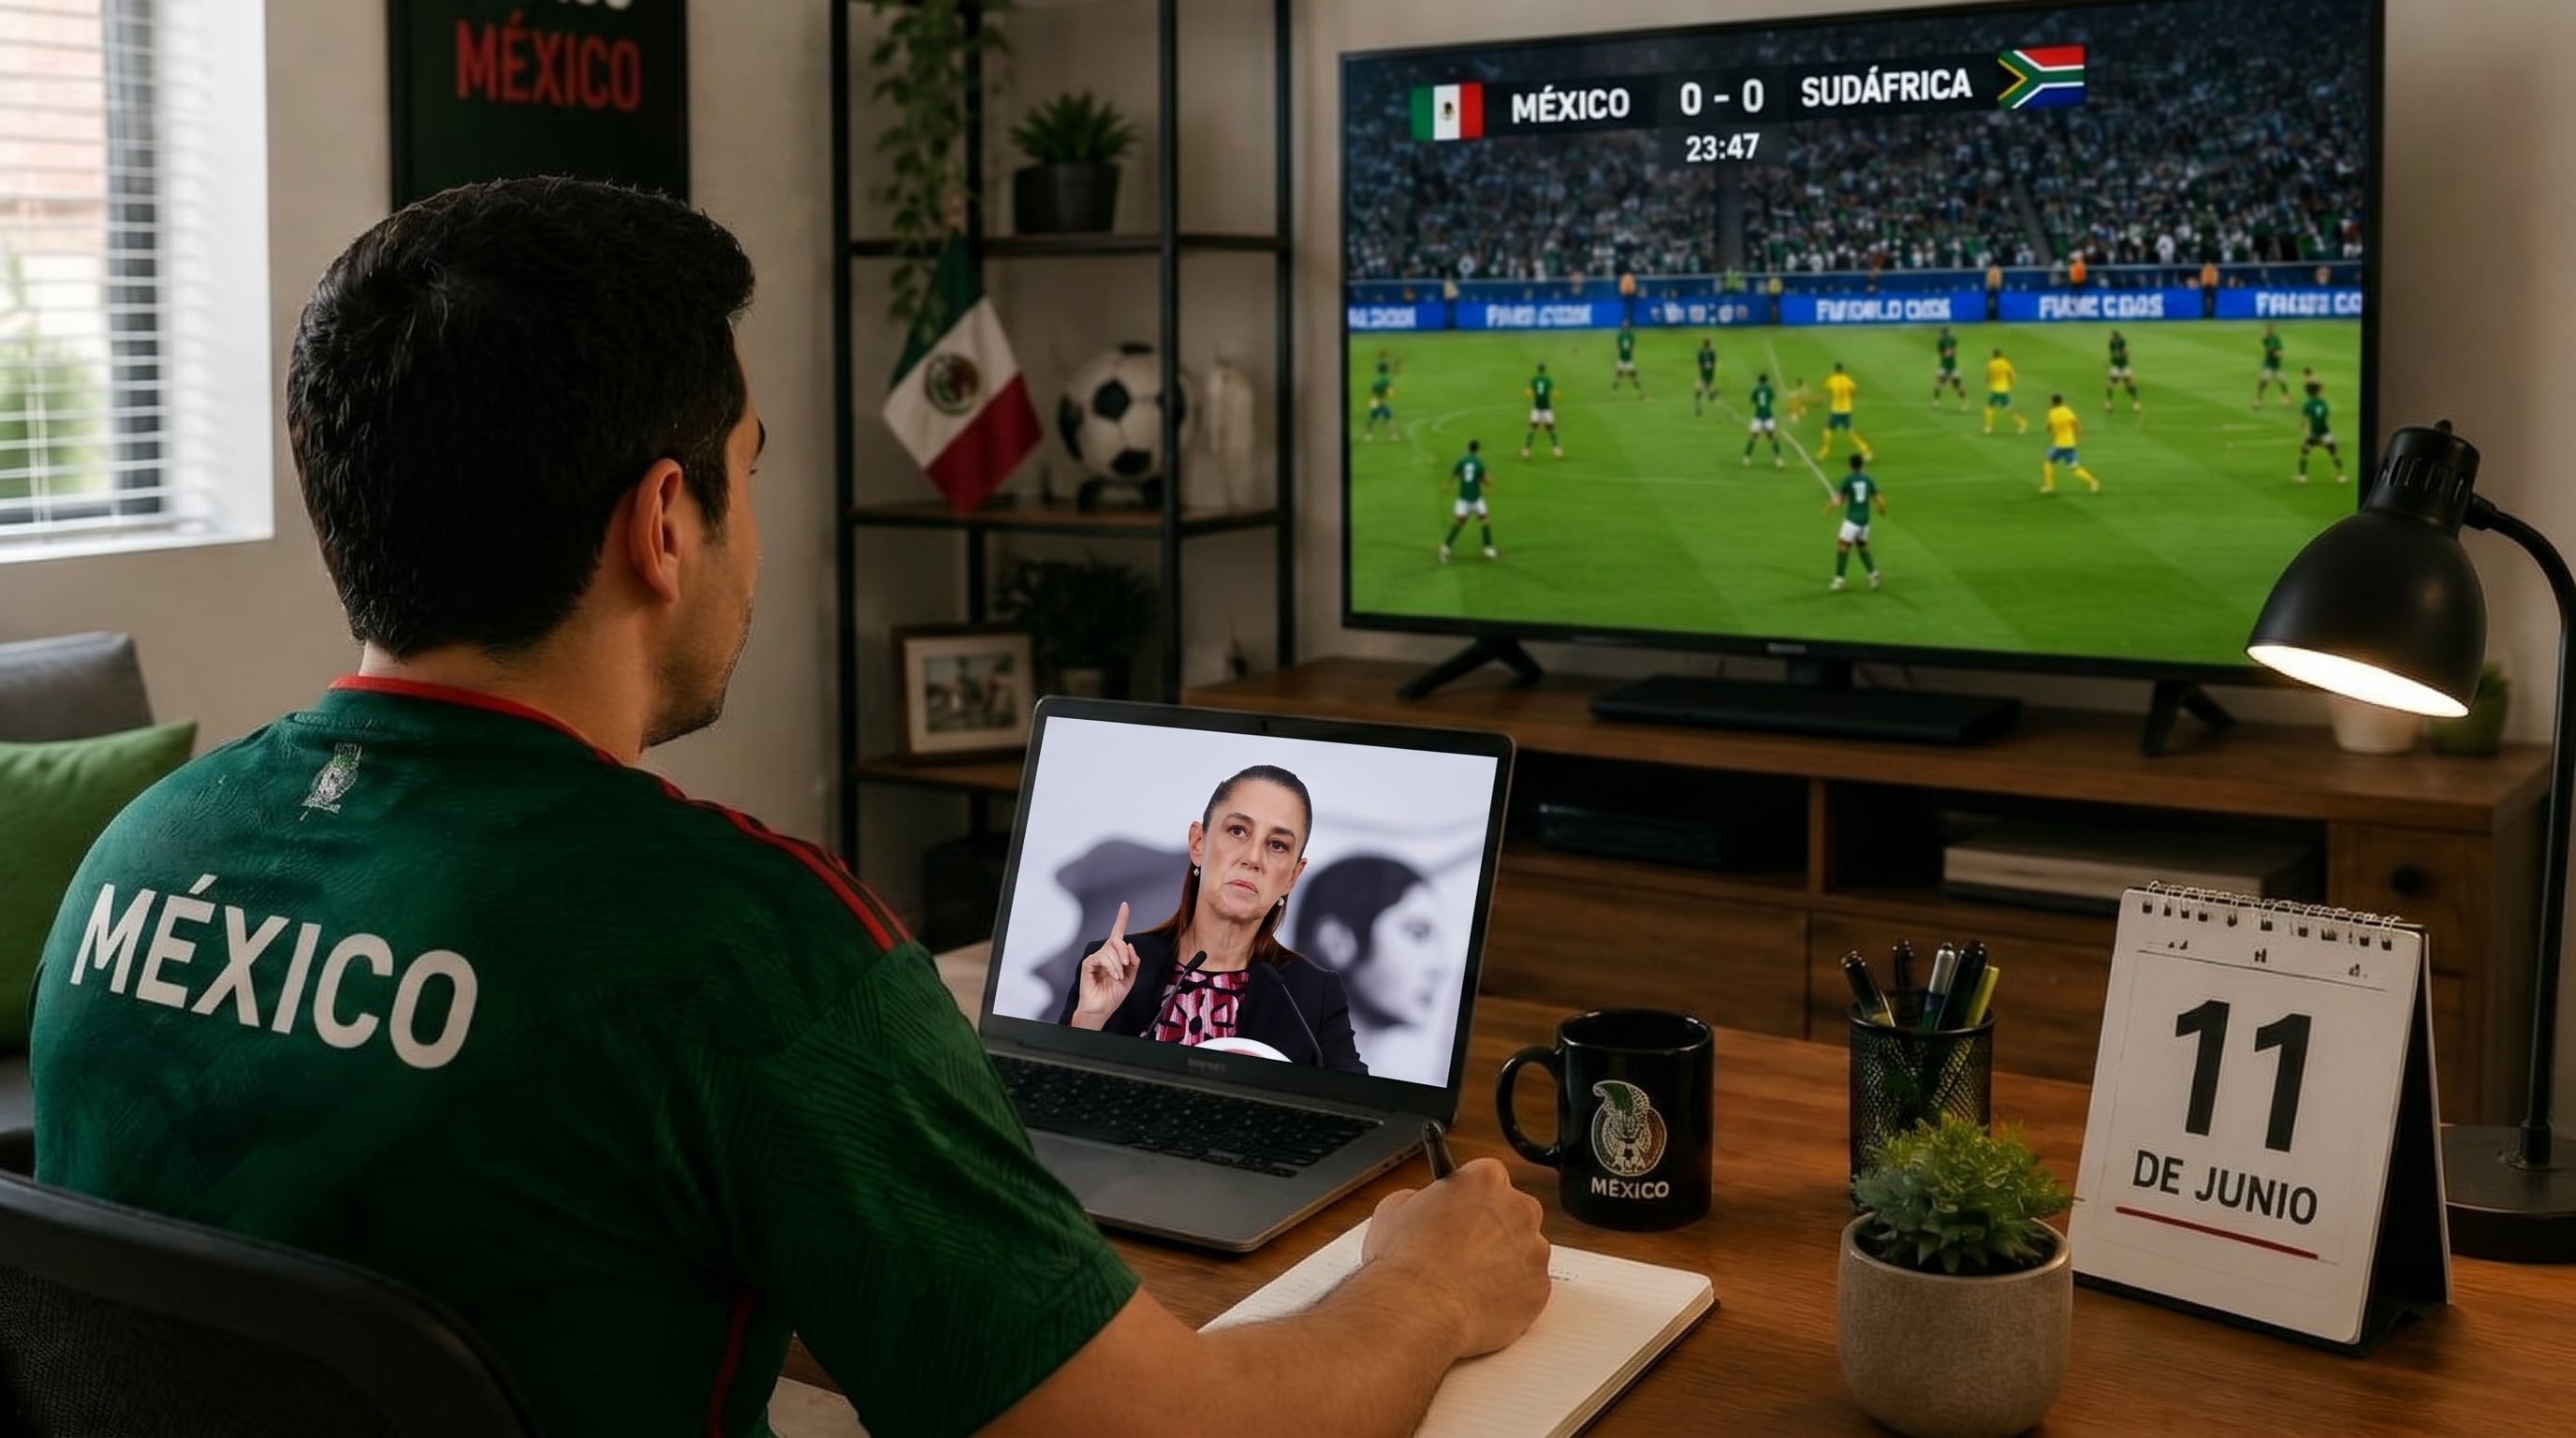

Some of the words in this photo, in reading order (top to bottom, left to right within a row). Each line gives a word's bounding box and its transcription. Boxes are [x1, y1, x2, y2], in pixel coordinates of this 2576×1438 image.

[456, 10, 641, 112] MÉXICO
[1512, 84, 1631, 124] MÉXICO
[1680, 81, 1703, 116] 0
[1742, 78, 1764, 112] 0
[1801, 66, 1973, 108] SUDÁFRICA
[1686, 132, 1760, 162] 23:47
[69, 873, 478, 1069] MÉXICO
[2174, 999, 2312, 1153] 11
[2131, 1150, 2184, 1196] DE
[2195, 1167, 2319, 1225] JUNIO
